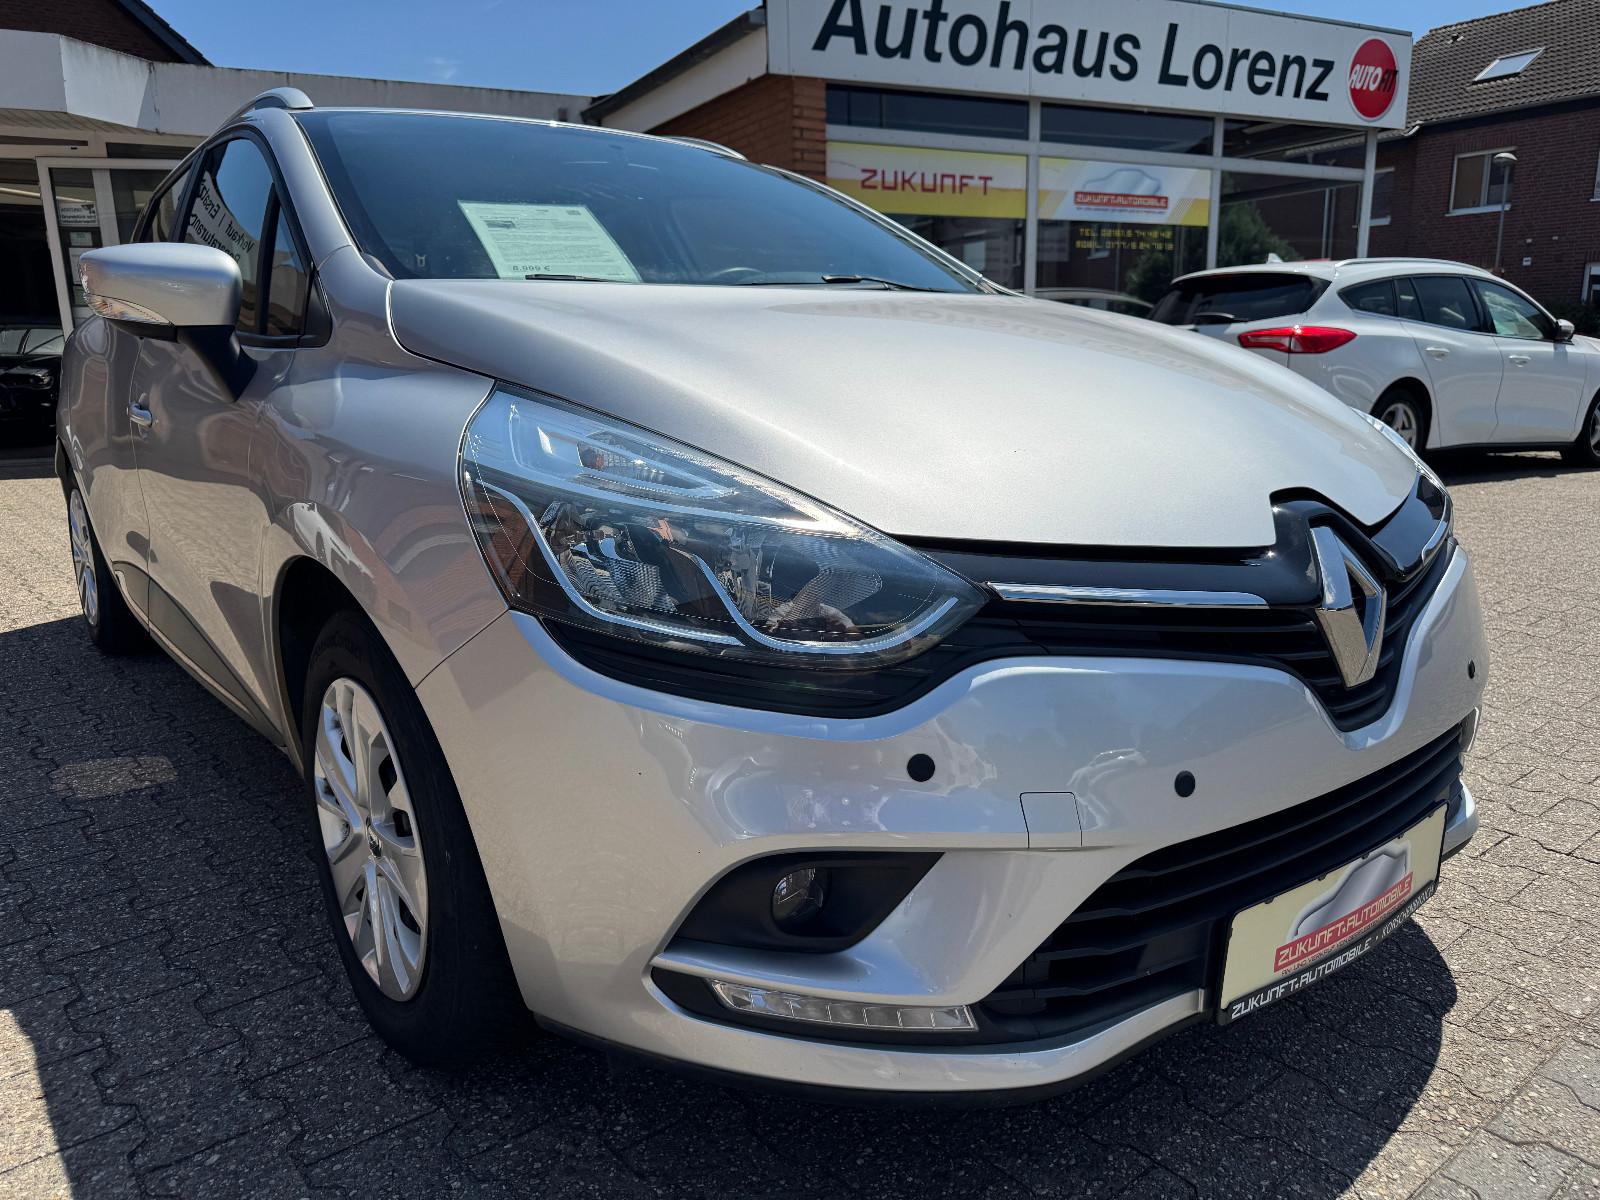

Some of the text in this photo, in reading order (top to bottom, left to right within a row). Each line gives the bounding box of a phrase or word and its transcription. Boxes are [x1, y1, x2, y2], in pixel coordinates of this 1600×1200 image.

[811, 0, 1335, 102] Autohaus Lorenz
[860, 168, 993, 196] ZUKUNFT
